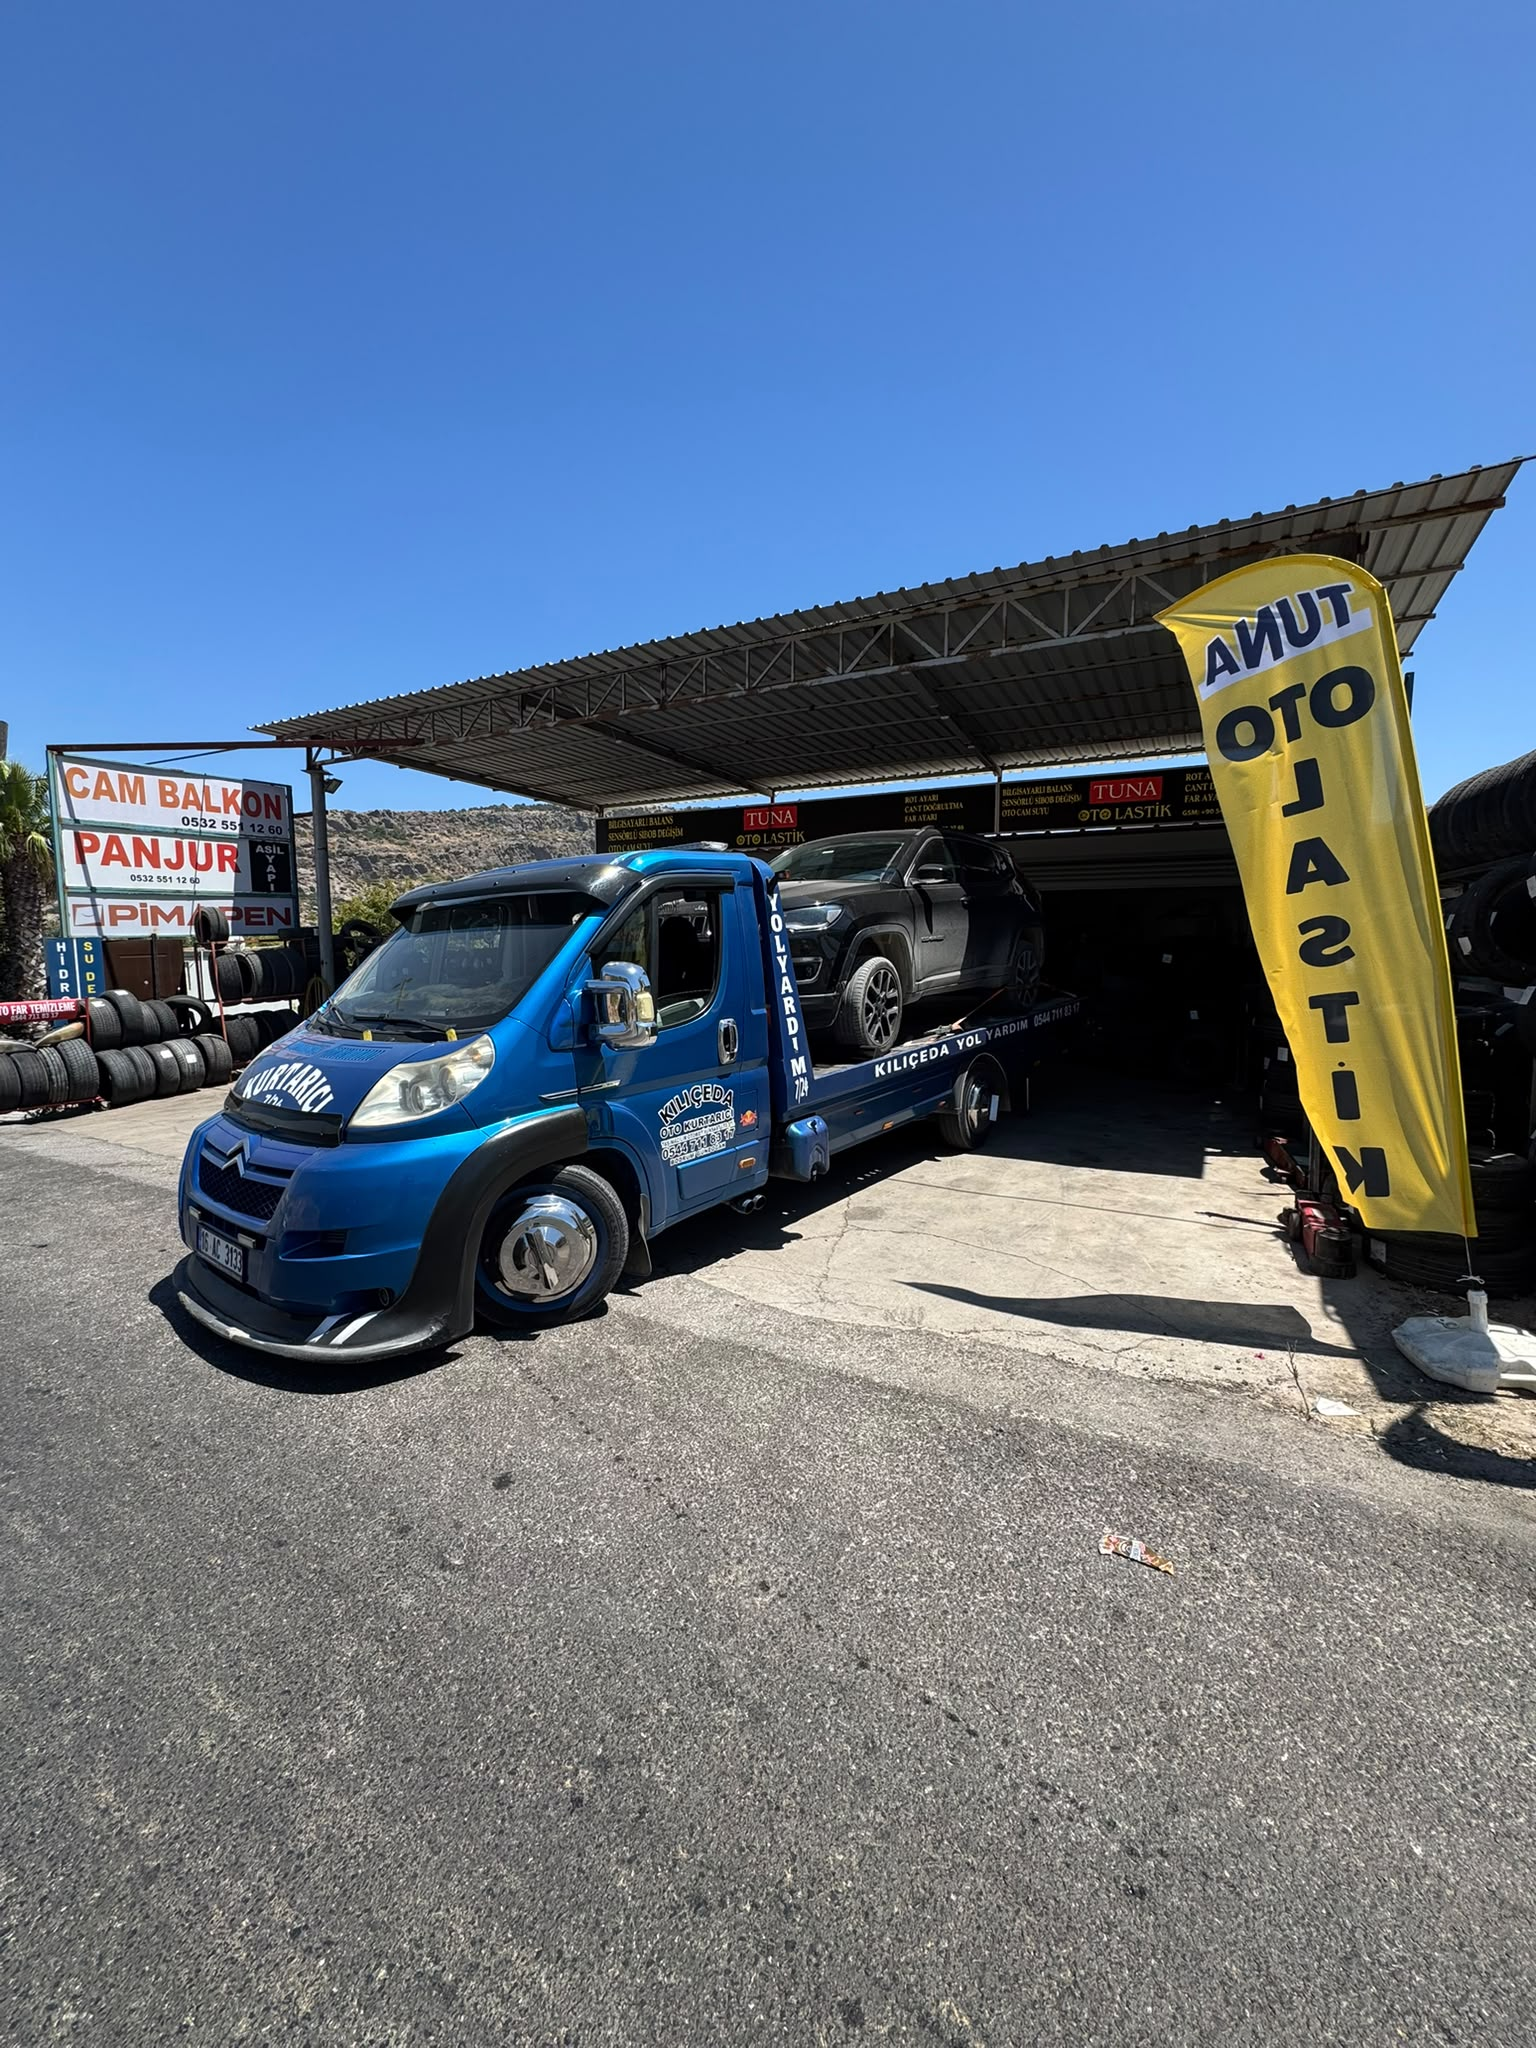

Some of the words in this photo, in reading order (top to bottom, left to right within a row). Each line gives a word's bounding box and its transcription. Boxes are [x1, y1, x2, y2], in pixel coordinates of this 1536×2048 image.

[1185, 773, 1202, 782] ROT
[66, 767, 146, 805] CAM
[158, 779, 282, 820] BALKON
[1046, 784, 1073, 794] BALANS
[1093, 781, 1158, 800] TUNA
[1184, 783, 1209, 792] CANT
[904, 795, 918, 804] ROT
[918, 794, 939, 803] AYARI
[1184, 794, 1201, 803] FAR
[747, 809, 794, 826] TUNA
[904, 805, 922, 814] CANT
[918, 813, 938, 823] AYARI
[1002, 808, 1016, 818] OTO
[1017, 807, 1031, 817] CAM
[1032, 806, 1050, 816] SUYU
[1078, 808, 1111, 822] OTO
[1114, 802, 1173, 820] LASTİK
[182, 817, 216, 829] 0532
[222, 820, 244, 832] 551
[250, 824, 264, 834] 12
[269, 825, 282, 835] 60
[649, 816, 674, 826] BALANS
[736, 834, 761, 846] OTO
[763, 829, 805, 845] LASTİK
[74, 831, 241, 873] PANJUR
[130, 874, 154, 883] 0532
[156, 875, 173, 884] 551
[176, 876, 187, 885] 12
[189, 877, 200, 885] 60
[265, 855, 277, 892] YAPI
[83, 941, 95, 964] SU
[56, 942, 71, 1000] HİDR
[10, 1004, 28, 1016] FAR
[29, 1001, 76, 1014] TEMİZLEME
[875, 1044, 949, 1079] KILIÇEDA
[956, 1034, 982, 1051] YOL
[986, 1019, 1028, 1041] YARDIM
[1034, 1011, 1050, 1028] 0544
[1052, 1008, 1063, 1022] 711
[1064, 1005, 1072, 1018] 83
[1073, 1001, 1081, 1015] 17
[242, 1062, 335, 1113] KURTARICI
[658, 1084, 734, 1126] KILIÇEDA
[660, 1123, 682, 1139] OTO
[683, 1108, 735, 1133] KURTARICI
[662, 1143, 689, 1161] 0544
[689, 1136, 708, 1150] 711
[710, 1131, 723, 1144] 83
[723, 1127, 736, 1140] 17
[224, 1243, 242, 1273] 3133
